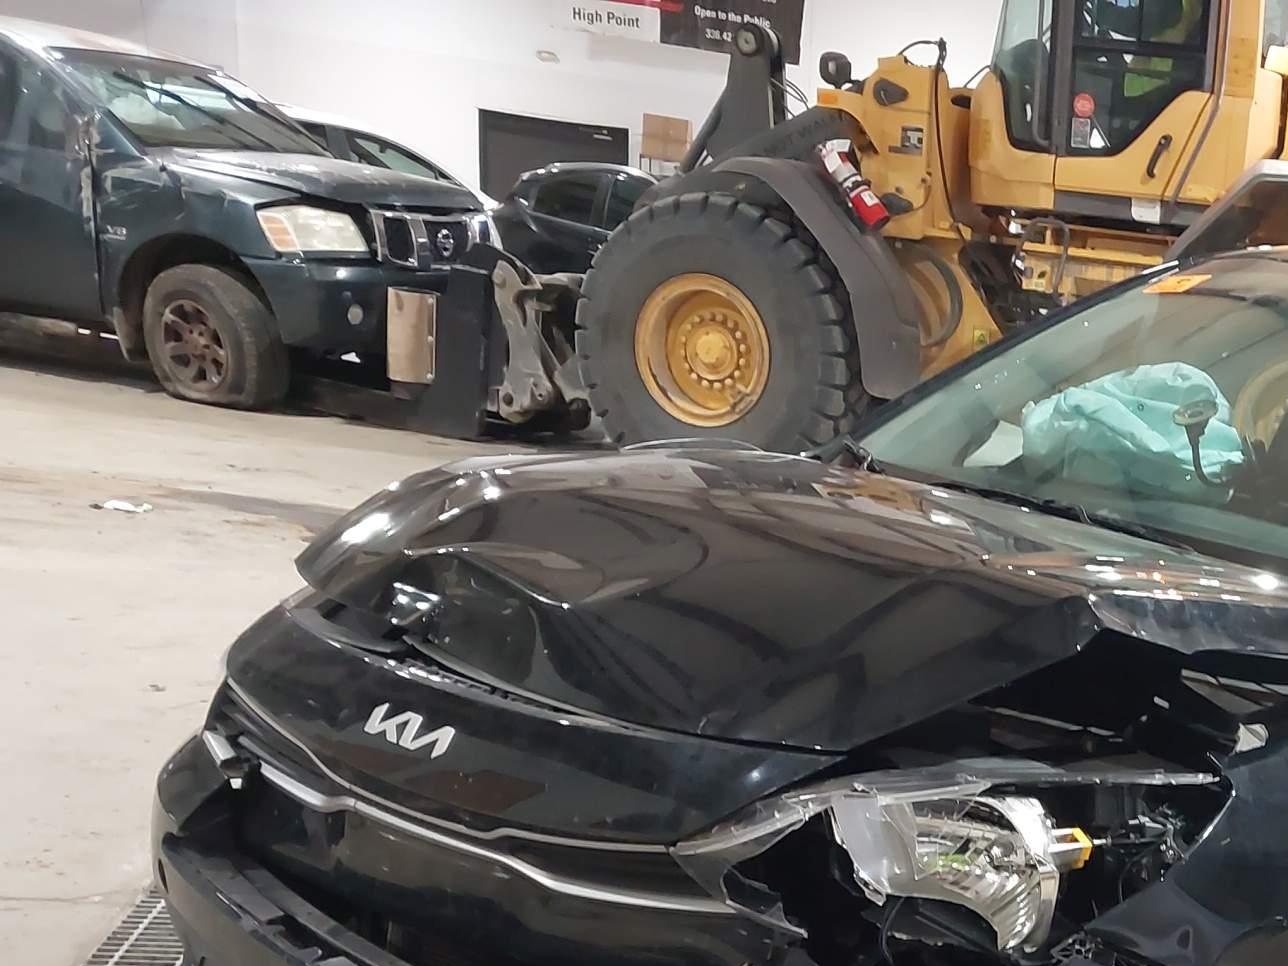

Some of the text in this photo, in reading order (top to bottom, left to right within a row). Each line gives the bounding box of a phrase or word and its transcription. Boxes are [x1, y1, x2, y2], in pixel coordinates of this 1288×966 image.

[572, 7, 641, 29] High Point
[694, 4, 771, 29] Open to the Public
[363, 702, 457, 760] KIA
